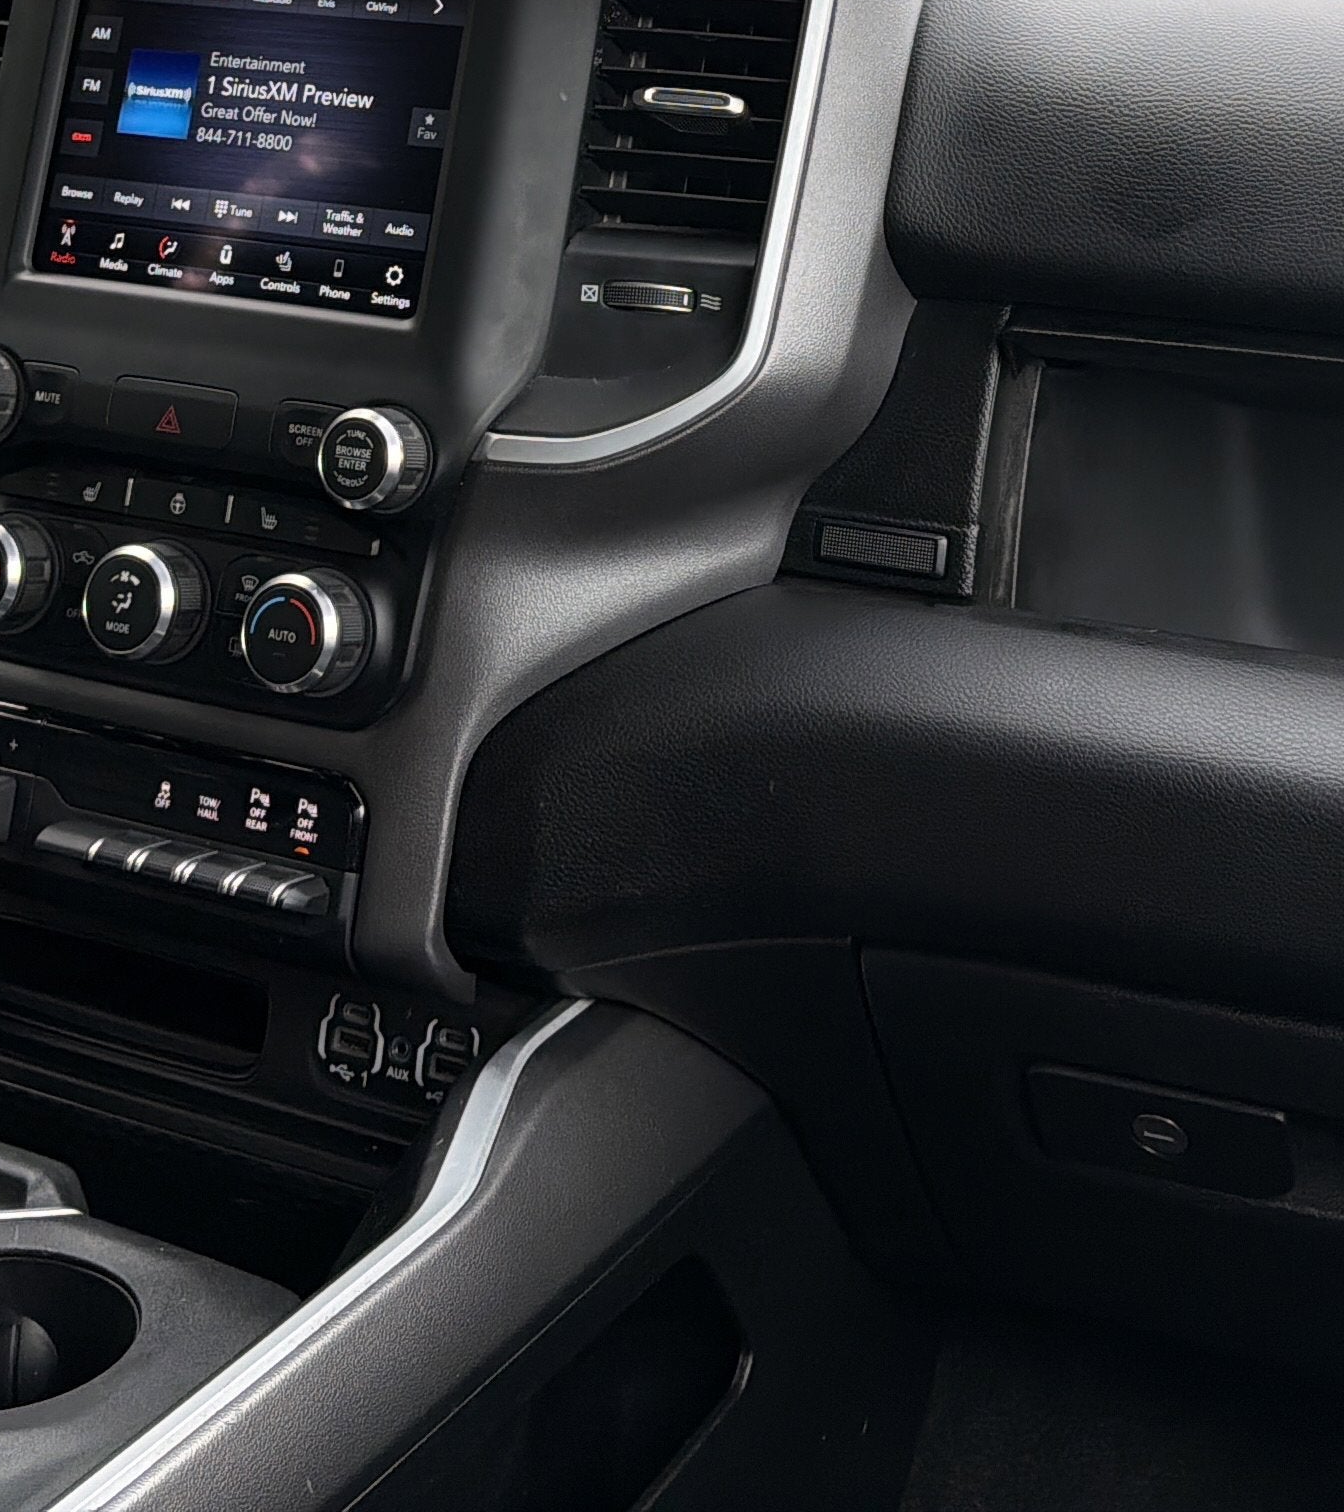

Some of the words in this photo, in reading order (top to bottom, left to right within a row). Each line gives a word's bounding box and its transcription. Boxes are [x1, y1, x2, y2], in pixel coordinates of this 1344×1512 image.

[91, 27, 111, 40] AM
[210, 51, 306, 75] Entertainment
[83, 79, 101, 91] FM
[207, 76, 215, 94] 1
[221, 76, 298, 102] SiriusXM
[303, 84, 374, 109] Preview
[201, 103, 238, 121] Great
[243, 106, 277, 124] Offer
[281, 109, 317, 127] Now!
[196, 127, 292, 151] 844-711-8800
[417, 128, 437, 140] Fav
[61, 186, 93, 200] Browse
[114, 191, 144, 207] Replay
[230, 205, 252, 218] Tune
[325, 209, 355, 224] Traffic
[355, 213, 364, 224] &
[323, 222, 363, 238] Weather
[385, 223, 414, 237] Audio
[50, 251, 76, 264] Radio
[99, 257, 129, 271] Media
[147, 263, 183, 279] Climate
[209, 271, 234, 286] Apps
[260, 278, 301, 294] Controls
[319, 285, 351, 300] Phone
[371, 292, 411, 310] Settings
[35, 390, 61, 405] MUTE
[288, 423, 323, 438] SCREEN
[346, 429, 366, 440] TUNE
[296, 436, 313, 447] OFF
[335, 444, 372, 459] BROWSE
[338, 459, 366, 471] ENTER
[337, 473, 364, 487] SCROLL
[105, 621, 130, 634] MODE
[268, 628, 296, 644] AUTO
[155, 798, 171, 809] OFF
[199, 795, 221, 810] TOW/
[197, 807, 219, 822] HAUL
[249, 807, 267, 819] OFF
[245, 818, 268, 832] REAR
[297, 817, 314, 829] OFF
[289, 828, 318, 843] FRONT
[361, 1070, 368, 1088] 1
[386, 1065, 409, 1082] AUX
